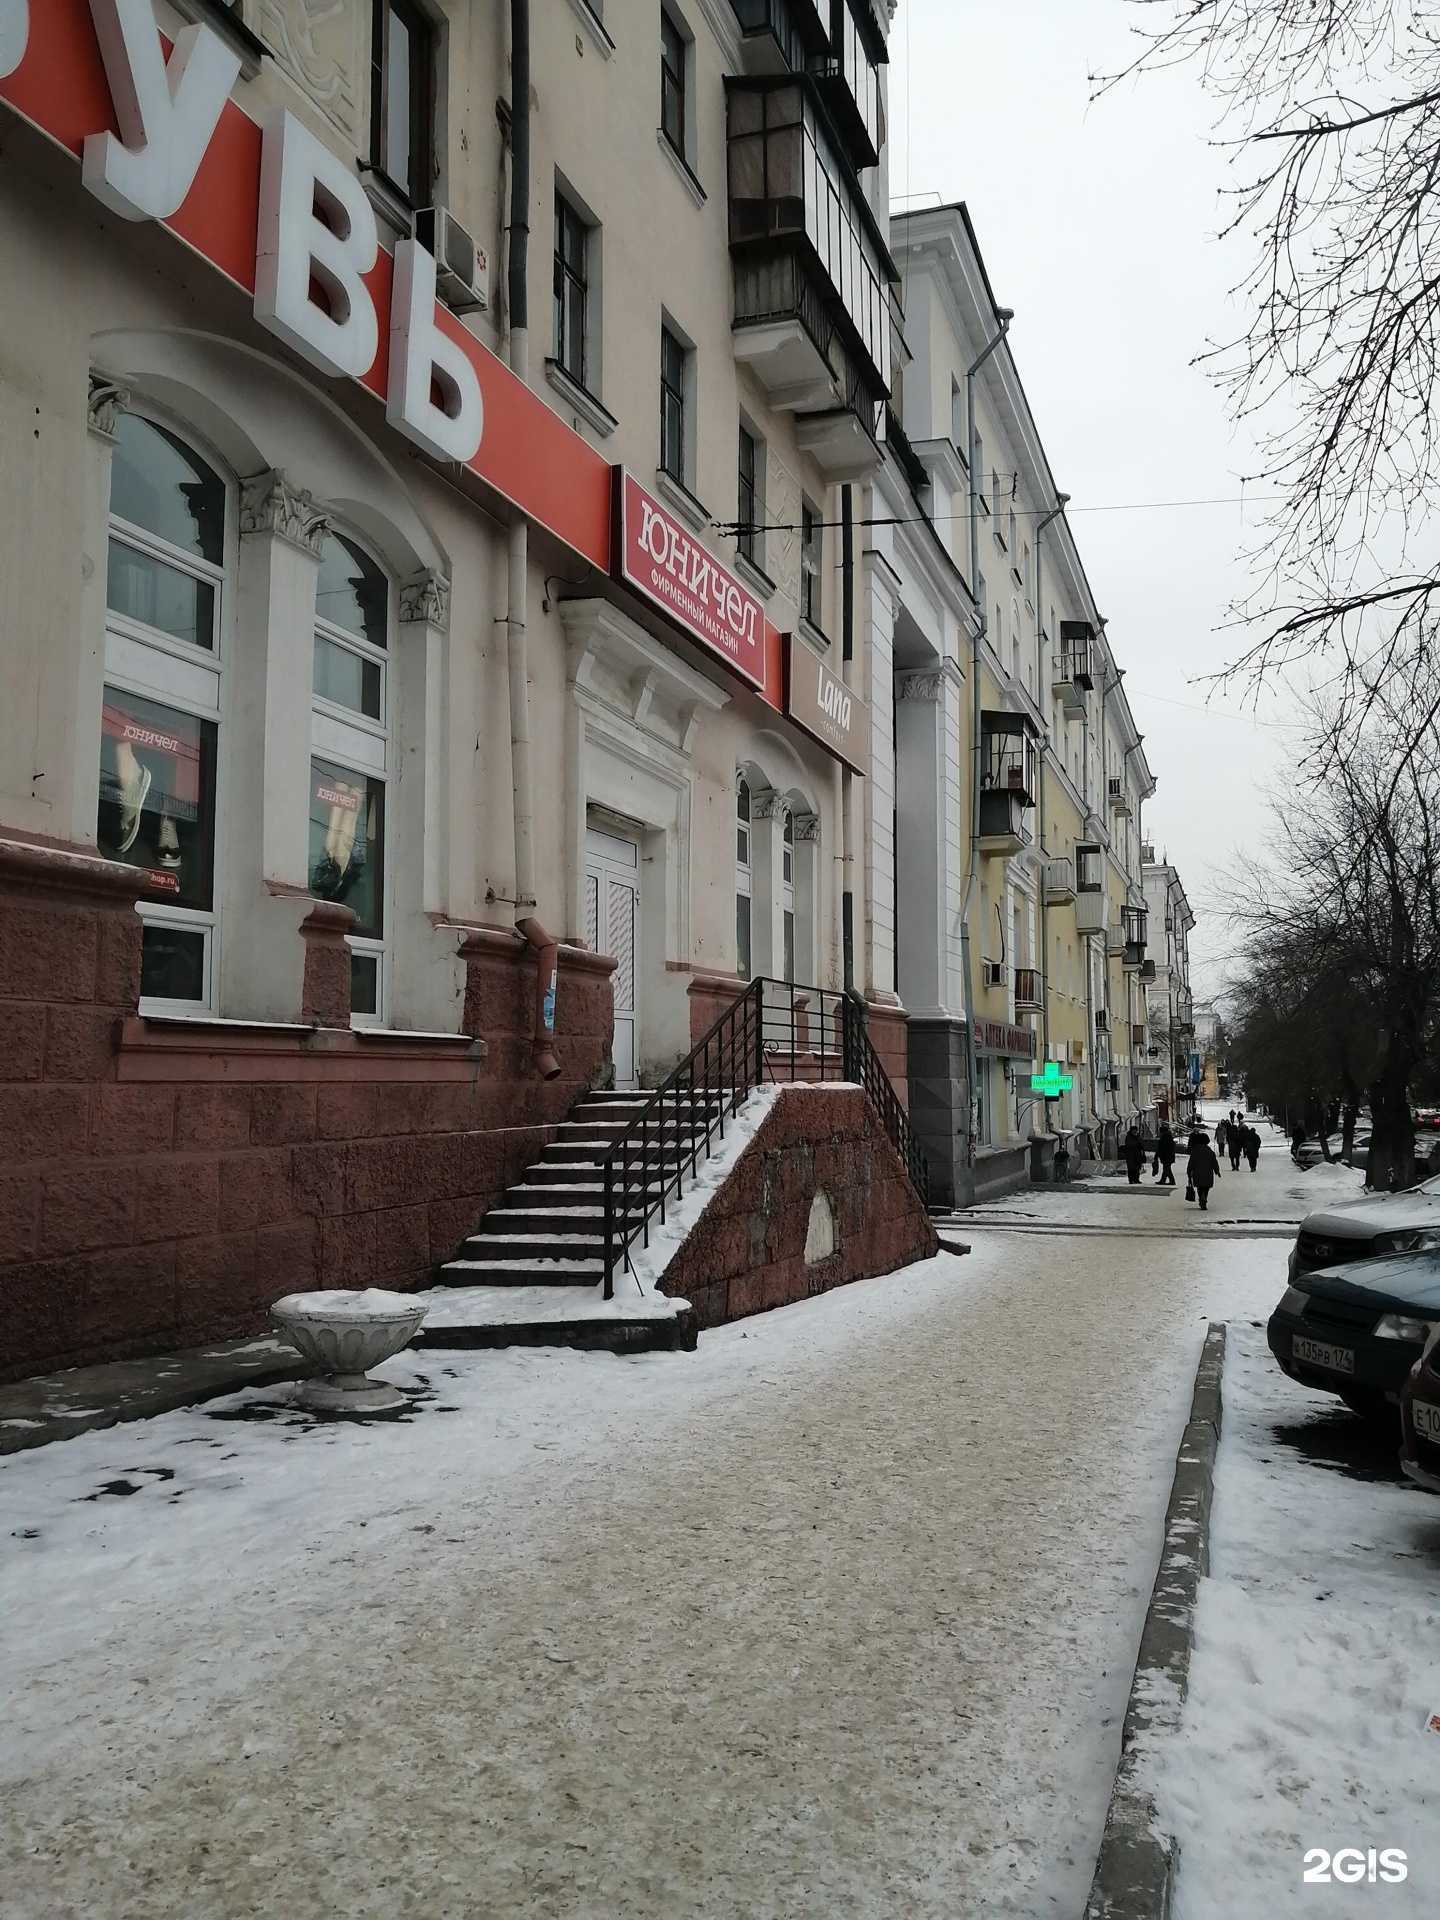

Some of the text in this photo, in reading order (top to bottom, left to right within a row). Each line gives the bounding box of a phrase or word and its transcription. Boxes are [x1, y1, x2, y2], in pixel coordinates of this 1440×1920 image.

[0, 0, 483, 462] УВЬ
[651, 567, 739, 655] ФИРМЕННЫЙ МАГАЗИН
[818, 664, 851, 732] Lana
